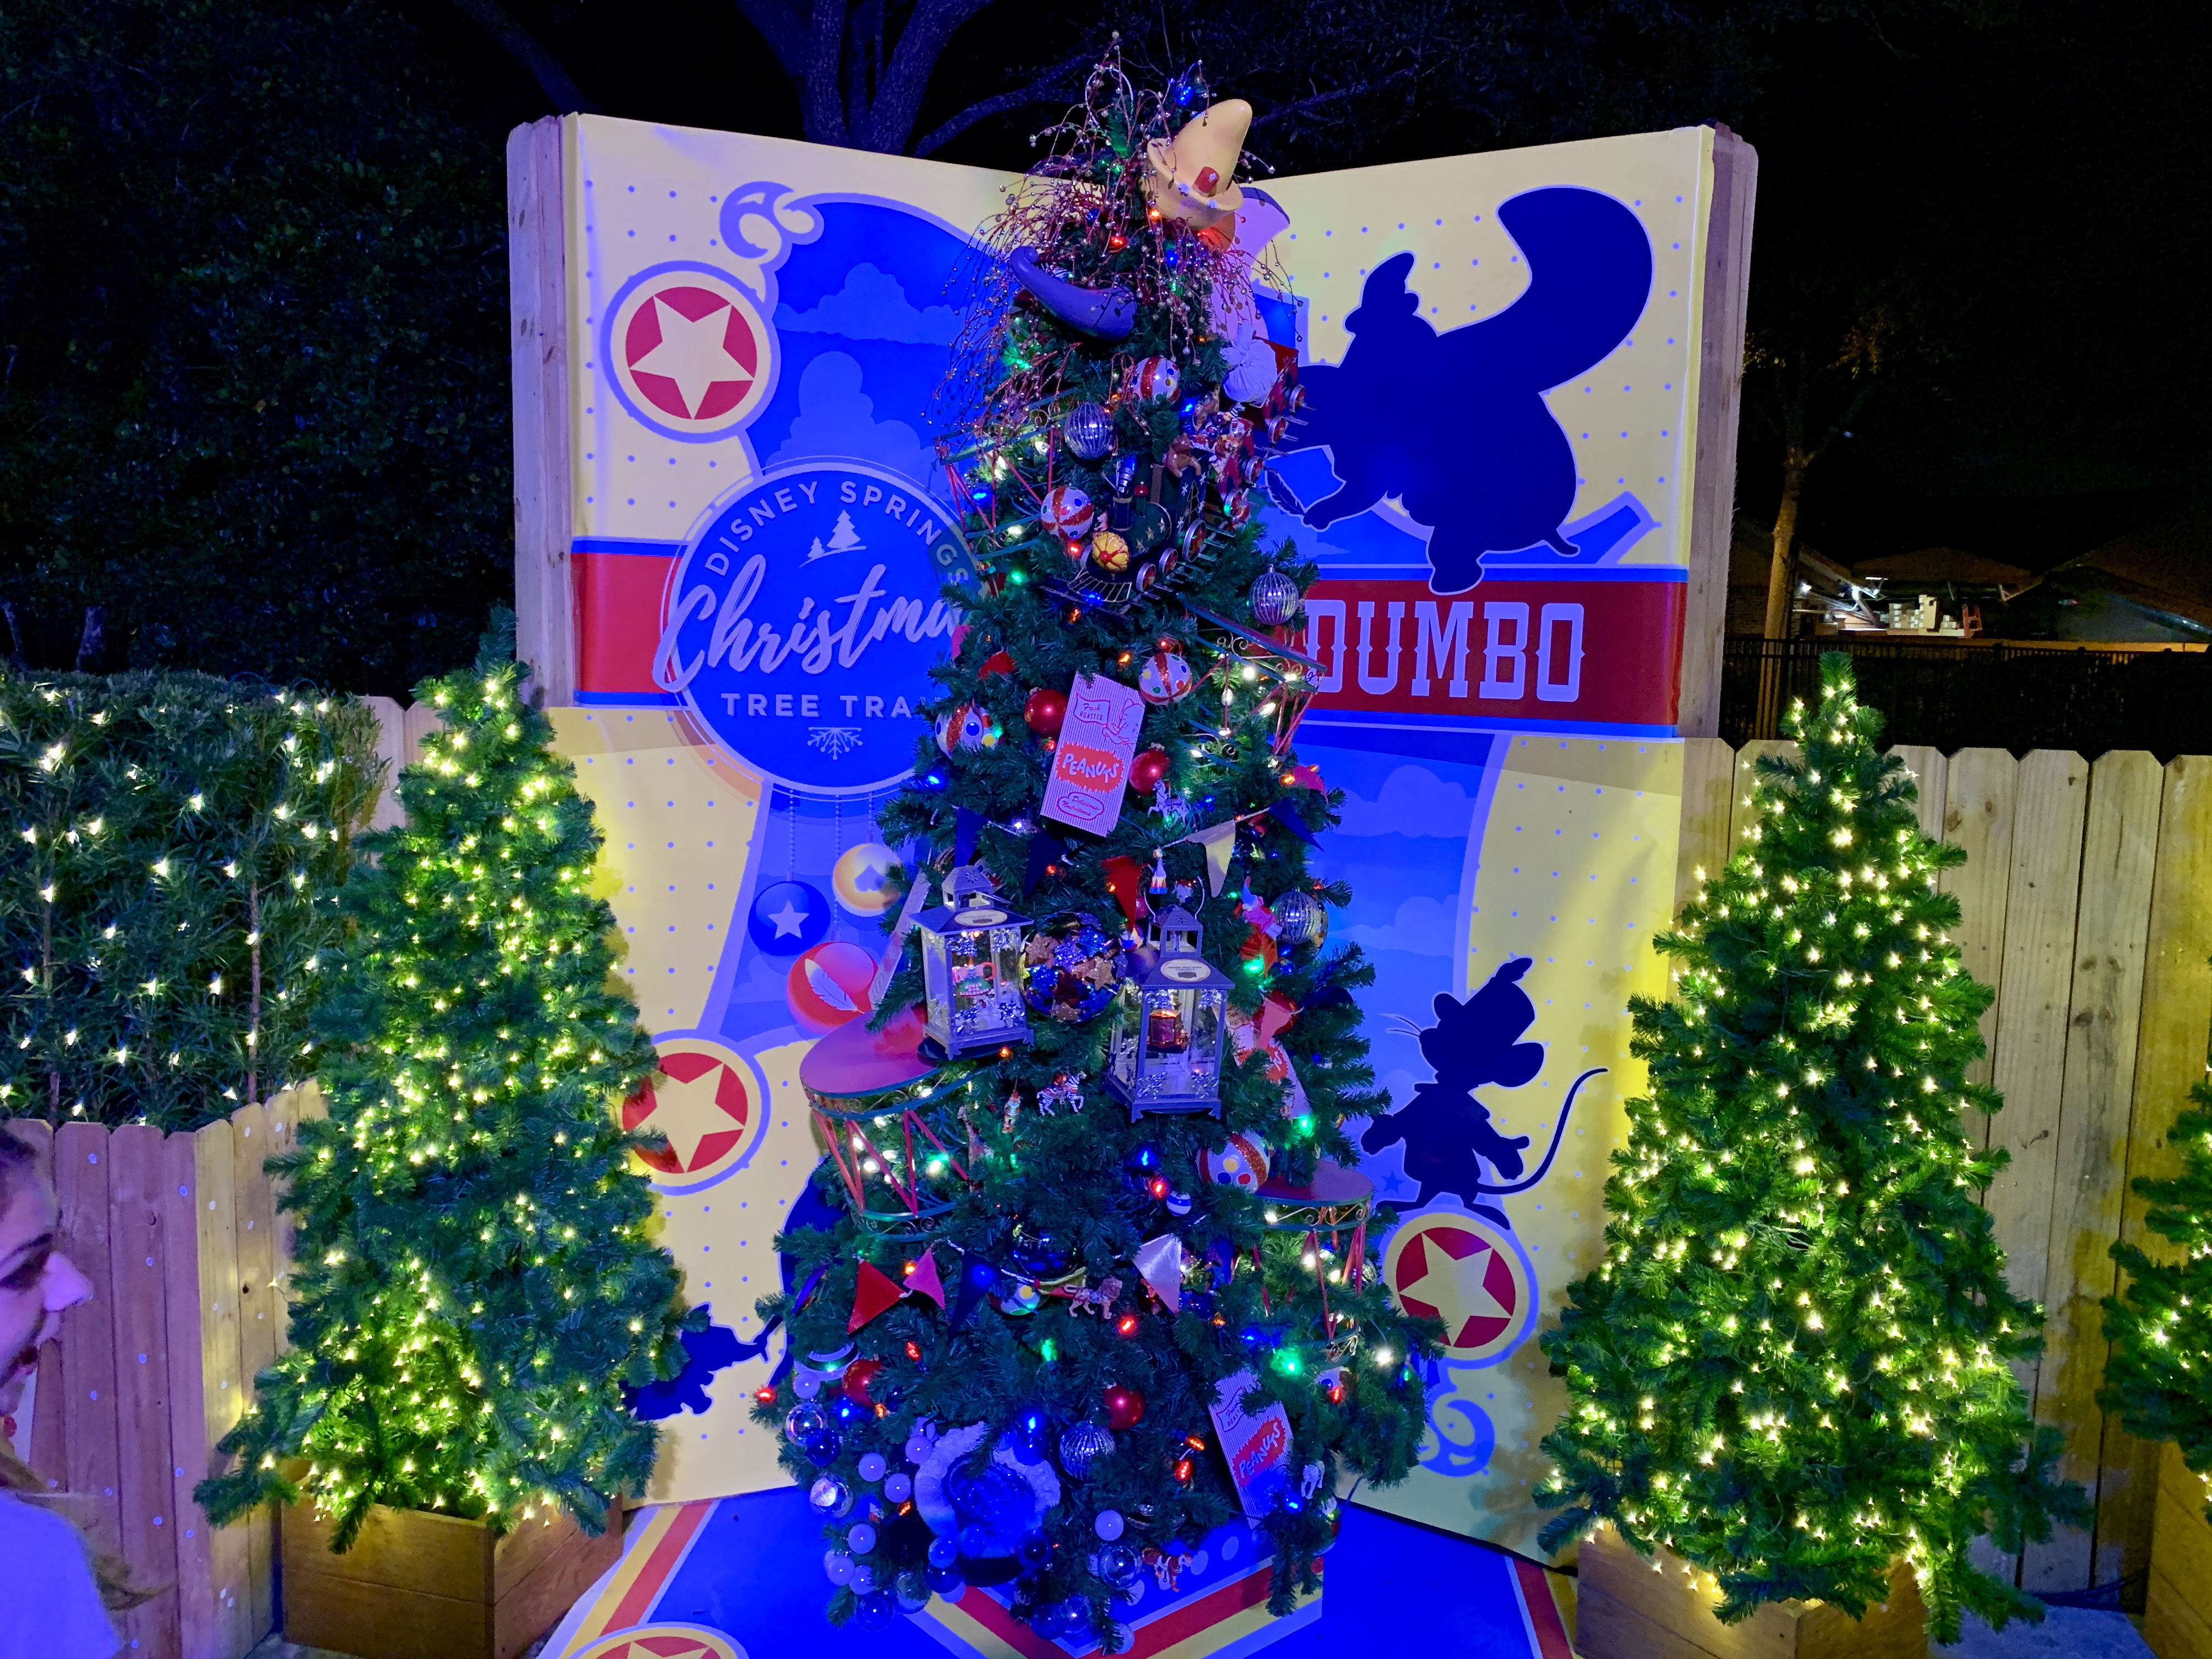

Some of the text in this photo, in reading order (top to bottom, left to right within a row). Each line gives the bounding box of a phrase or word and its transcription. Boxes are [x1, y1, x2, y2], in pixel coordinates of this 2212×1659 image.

[705, 481, 969, 586] DISNEY SPRINGS
[652, 554, 962, 692] Christma
[1304, 599, 1585, 702] DUMBO
[721, 693, 912, 719] TREE TRA
[1079, 711, 1103, 720] ROASTED
[1062, 753, 1119, 783] PEANUTS
[1239, 1422, 1280, 1479] PEANUTS
